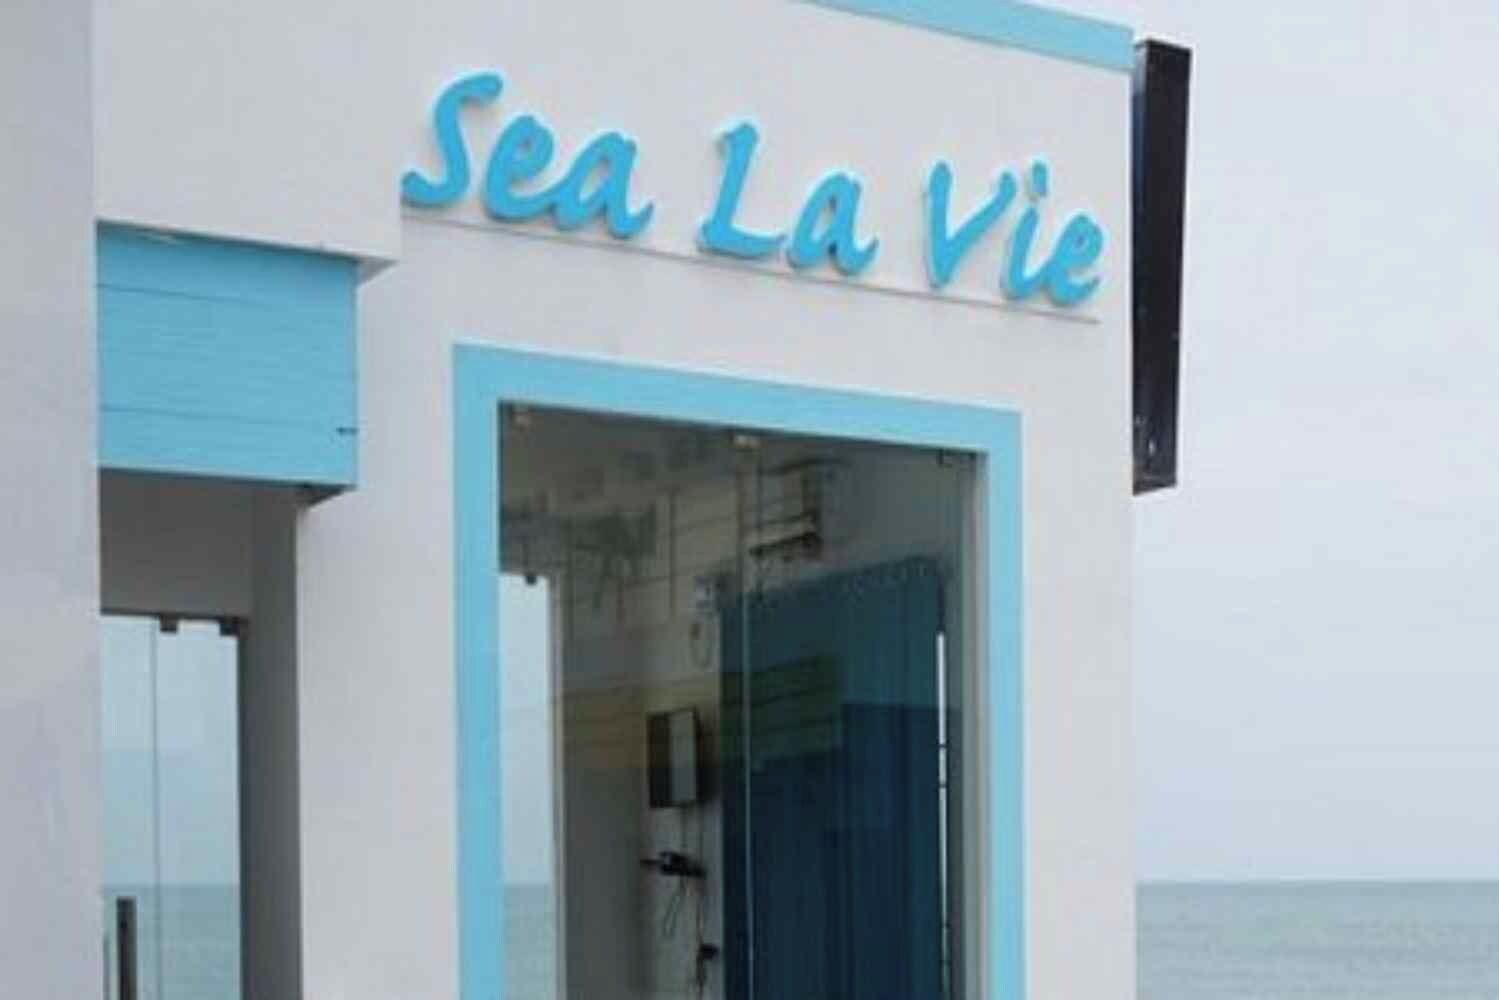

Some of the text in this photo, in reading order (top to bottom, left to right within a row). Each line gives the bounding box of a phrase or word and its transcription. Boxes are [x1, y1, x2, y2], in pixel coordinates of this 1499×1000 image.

[400, 71, 1107, 304] Sea La Vie
